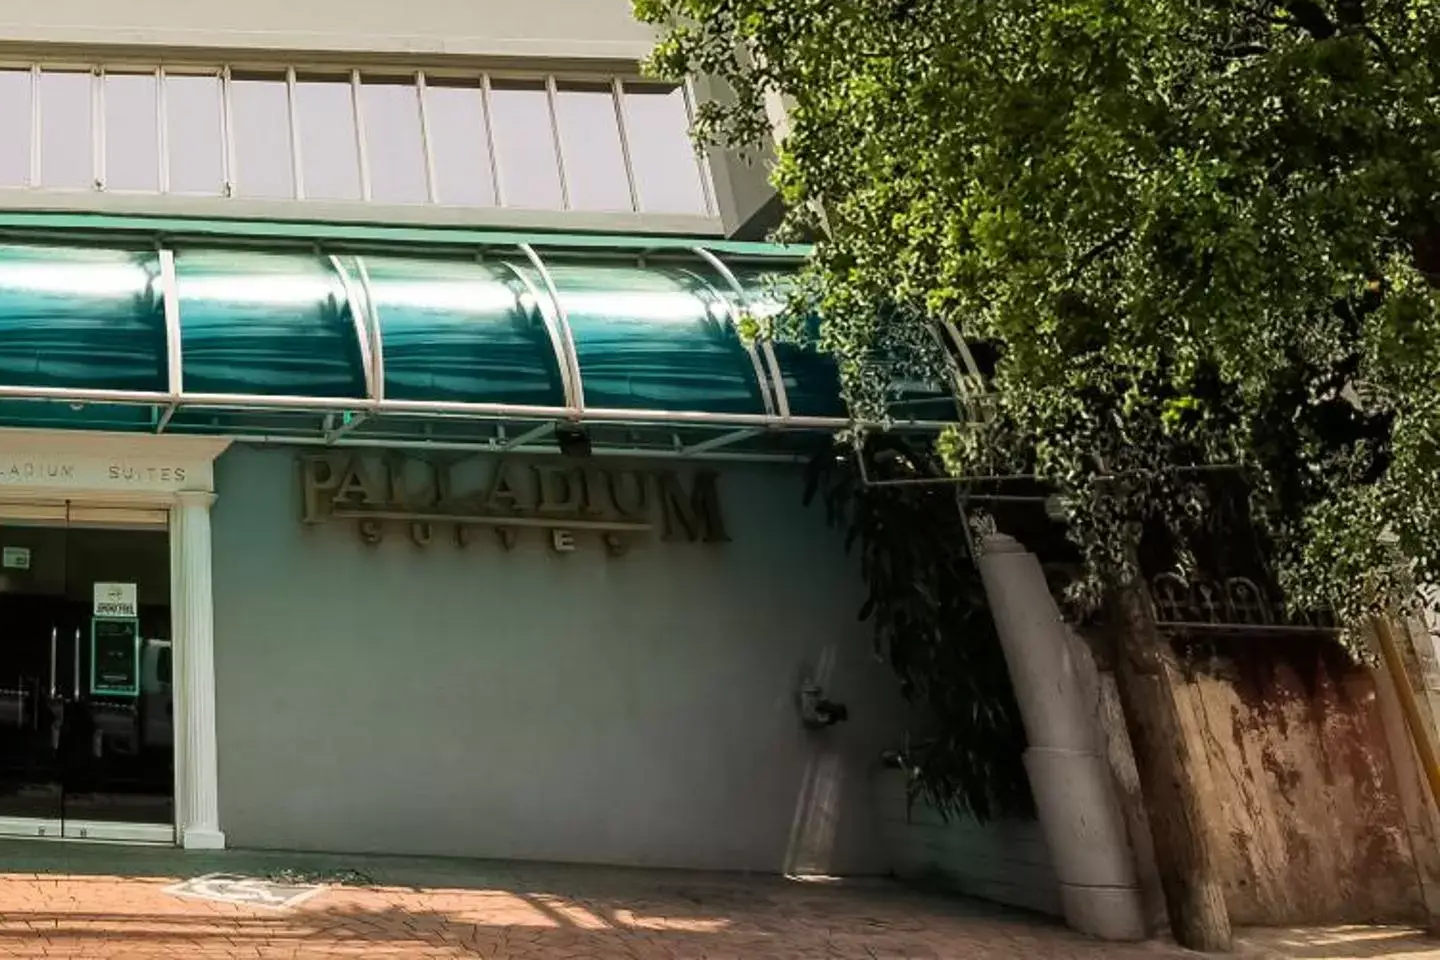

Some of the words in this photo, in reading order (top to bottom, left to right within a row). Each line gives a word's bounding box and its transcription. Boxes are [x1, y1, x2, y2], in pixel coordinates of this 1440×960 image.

[109, 465, 186, 482] SUITES
[298, 452, 732, 543] PALLADIUM
[359, 520, 626, 555] SUITES
